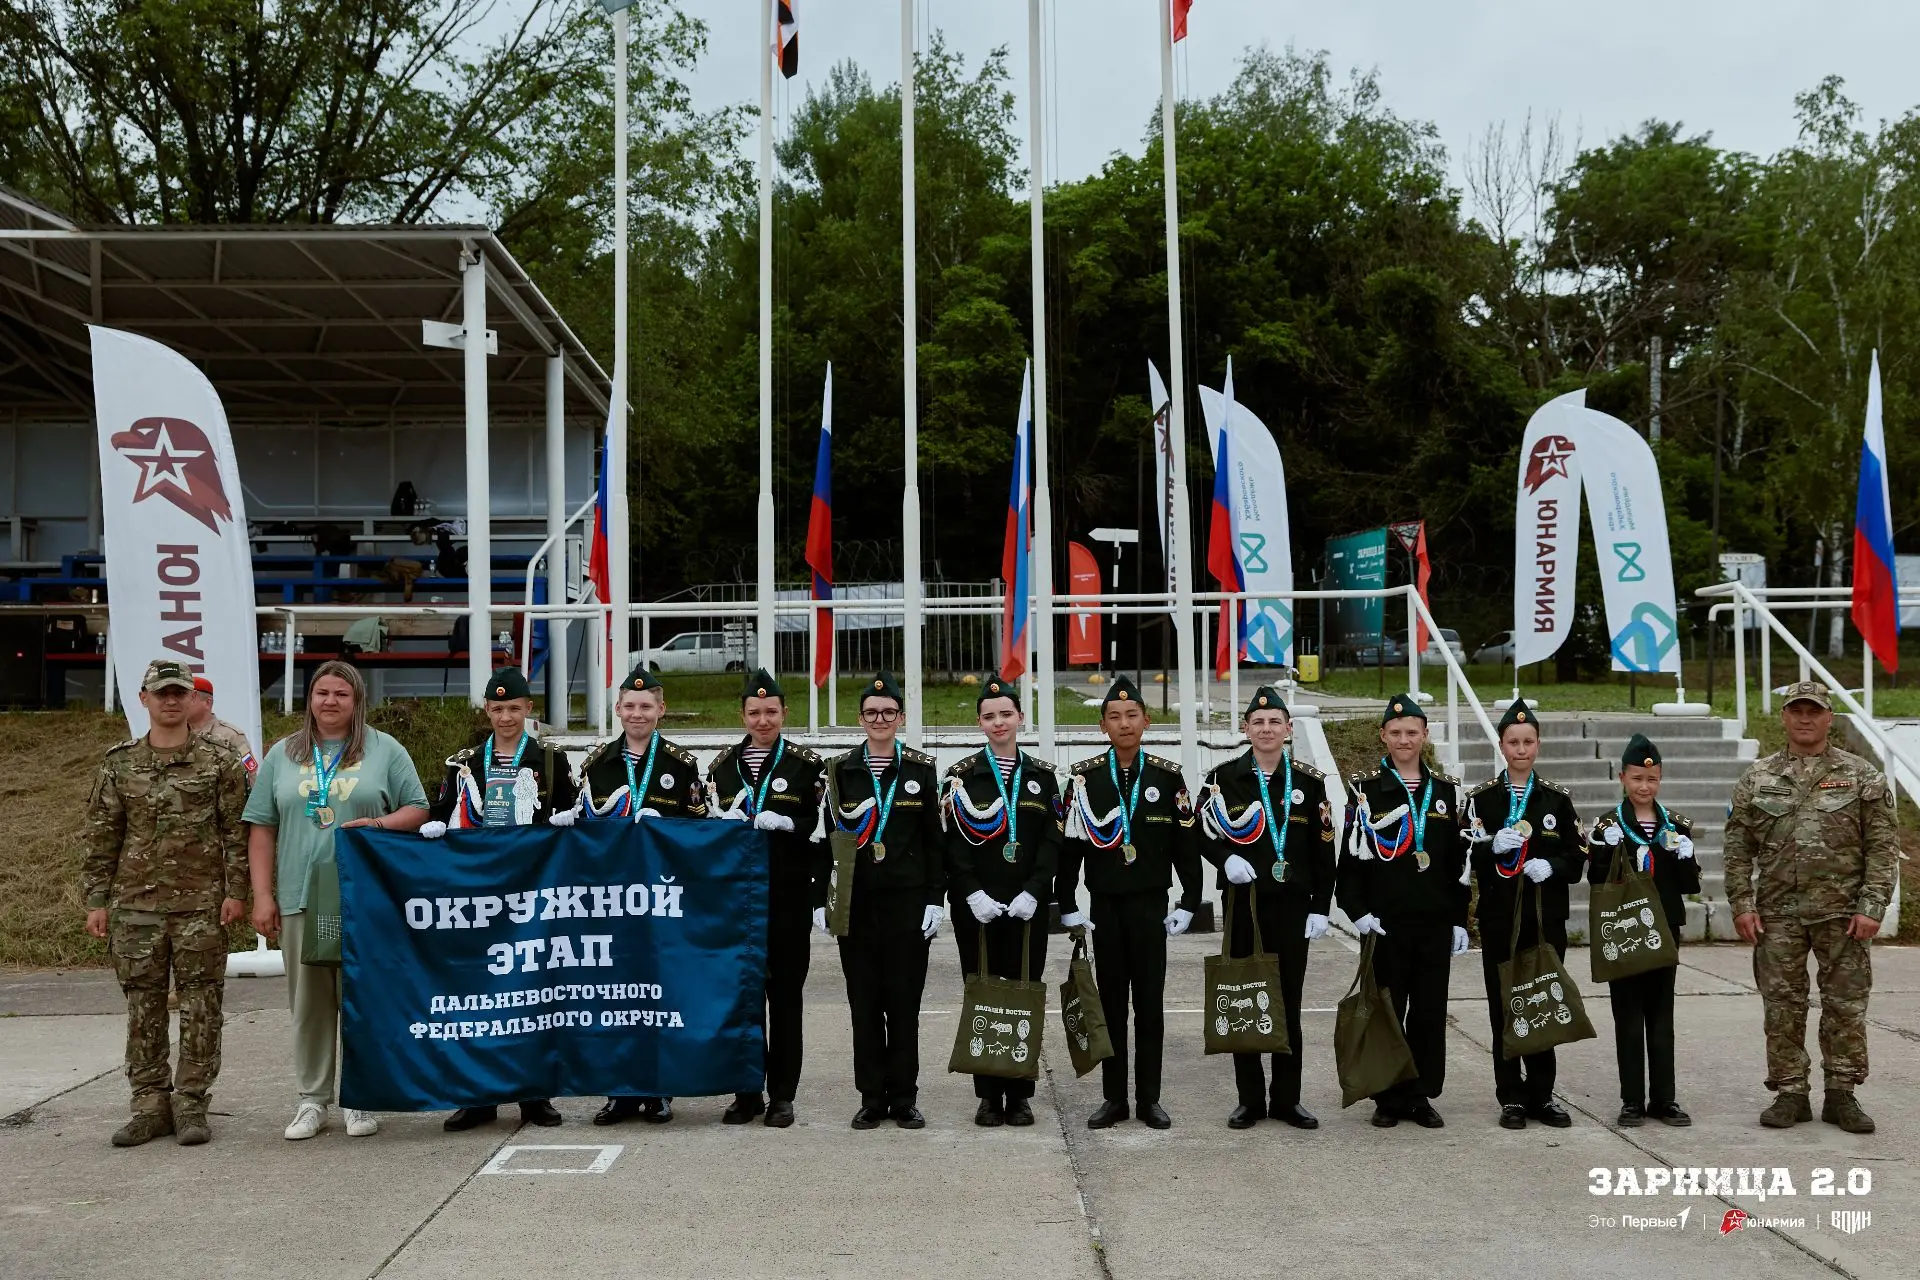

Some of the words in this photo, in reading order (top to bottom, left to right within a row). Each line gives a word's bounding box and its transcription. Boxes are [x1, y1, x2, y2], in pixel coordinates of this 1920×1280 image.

[1534, 499, 1558, 633] ЮНАРМИЯ
[495, 786, 504, 800] 1
[404, 875, 684, 931] ОКРУЖНОЙ
[487, 935, 614, 976] ЭТАП
[430, 983, 663, 1014] ДАЛЬНЕВОСТОЧНОГО
[409, 1010, 593, 1041] ФЕДЕРАЛЬНОГО
[600, 1011, 685, 1029] ОКРУГА
